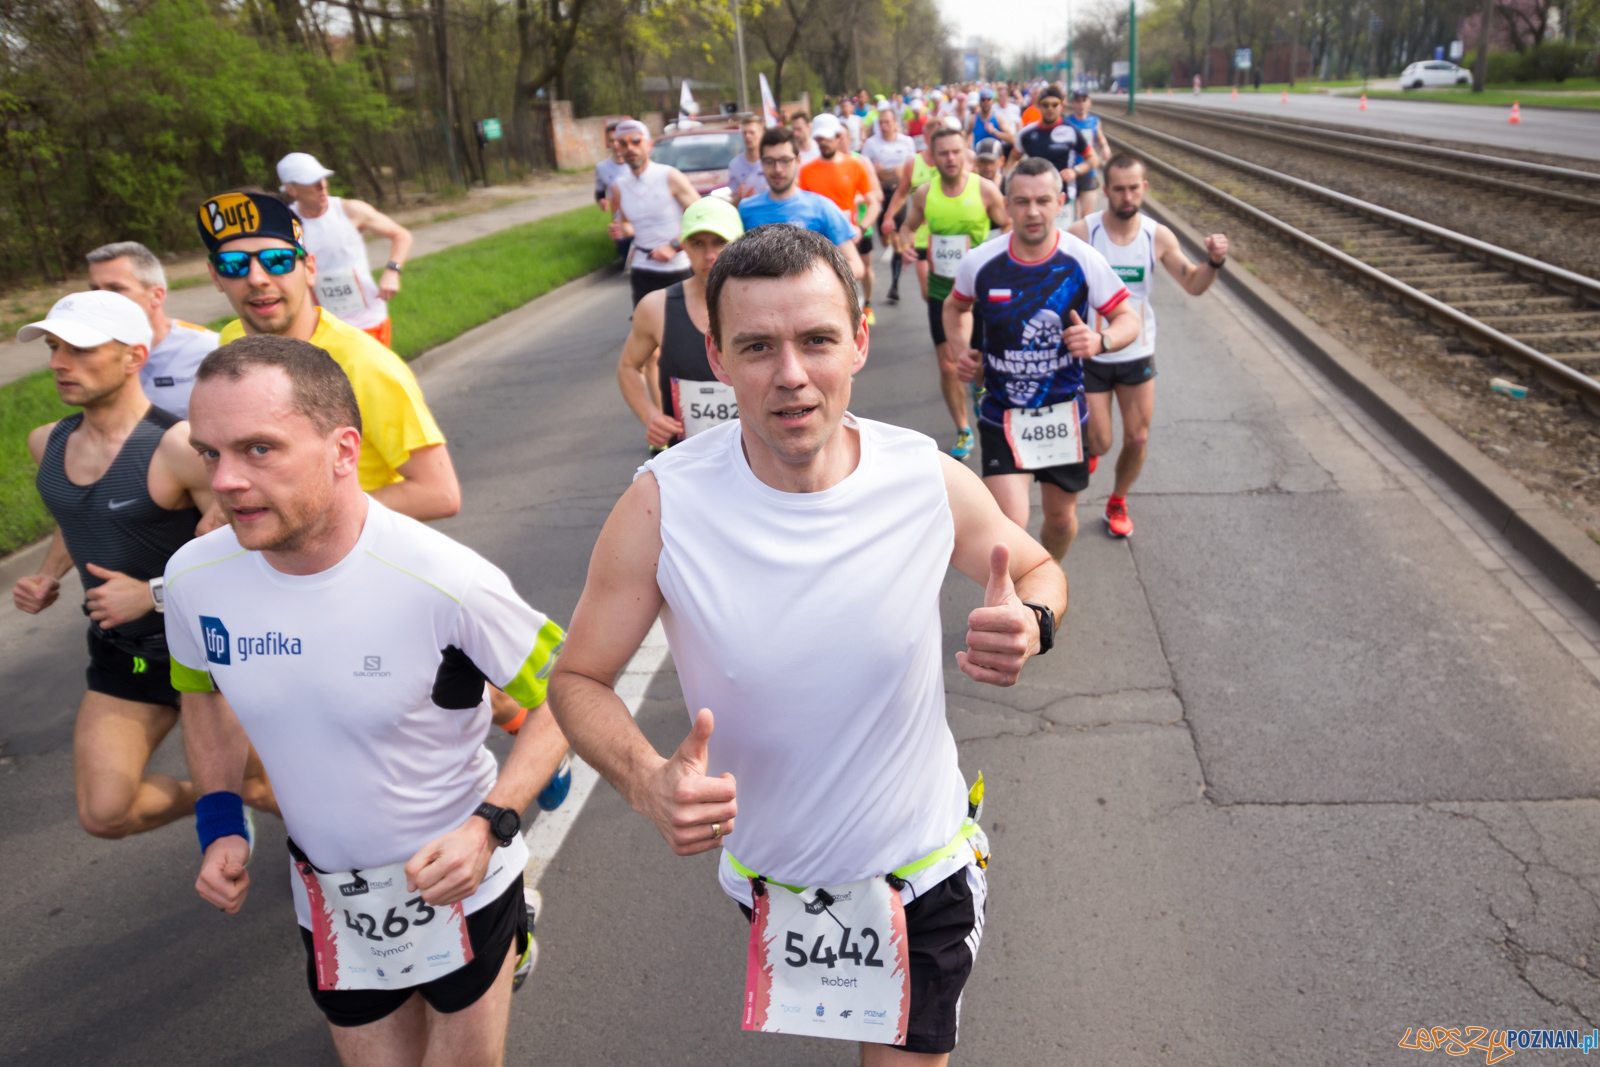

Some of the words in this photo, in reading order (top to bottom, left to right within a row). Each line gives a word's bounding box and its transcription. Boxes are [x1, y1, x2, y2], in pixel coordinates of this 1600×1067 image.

[936, 248, 962, 260] 6498
[320, 284, 352, 298] 1258
[690, 402, 739, 420] 5482
[1021, 422, 1068, 441] 4888
[205, 626, 225, 659] tfp
[237, 632, 302, 661] grafika
[343, 896, 436, 941] 4263
[370, 941, 414, 958] Szymon
[784, 927, 884, 969] 5442
[820, 976, 858, 988] Robert
[839, 1009, 853, 1018] 4F
